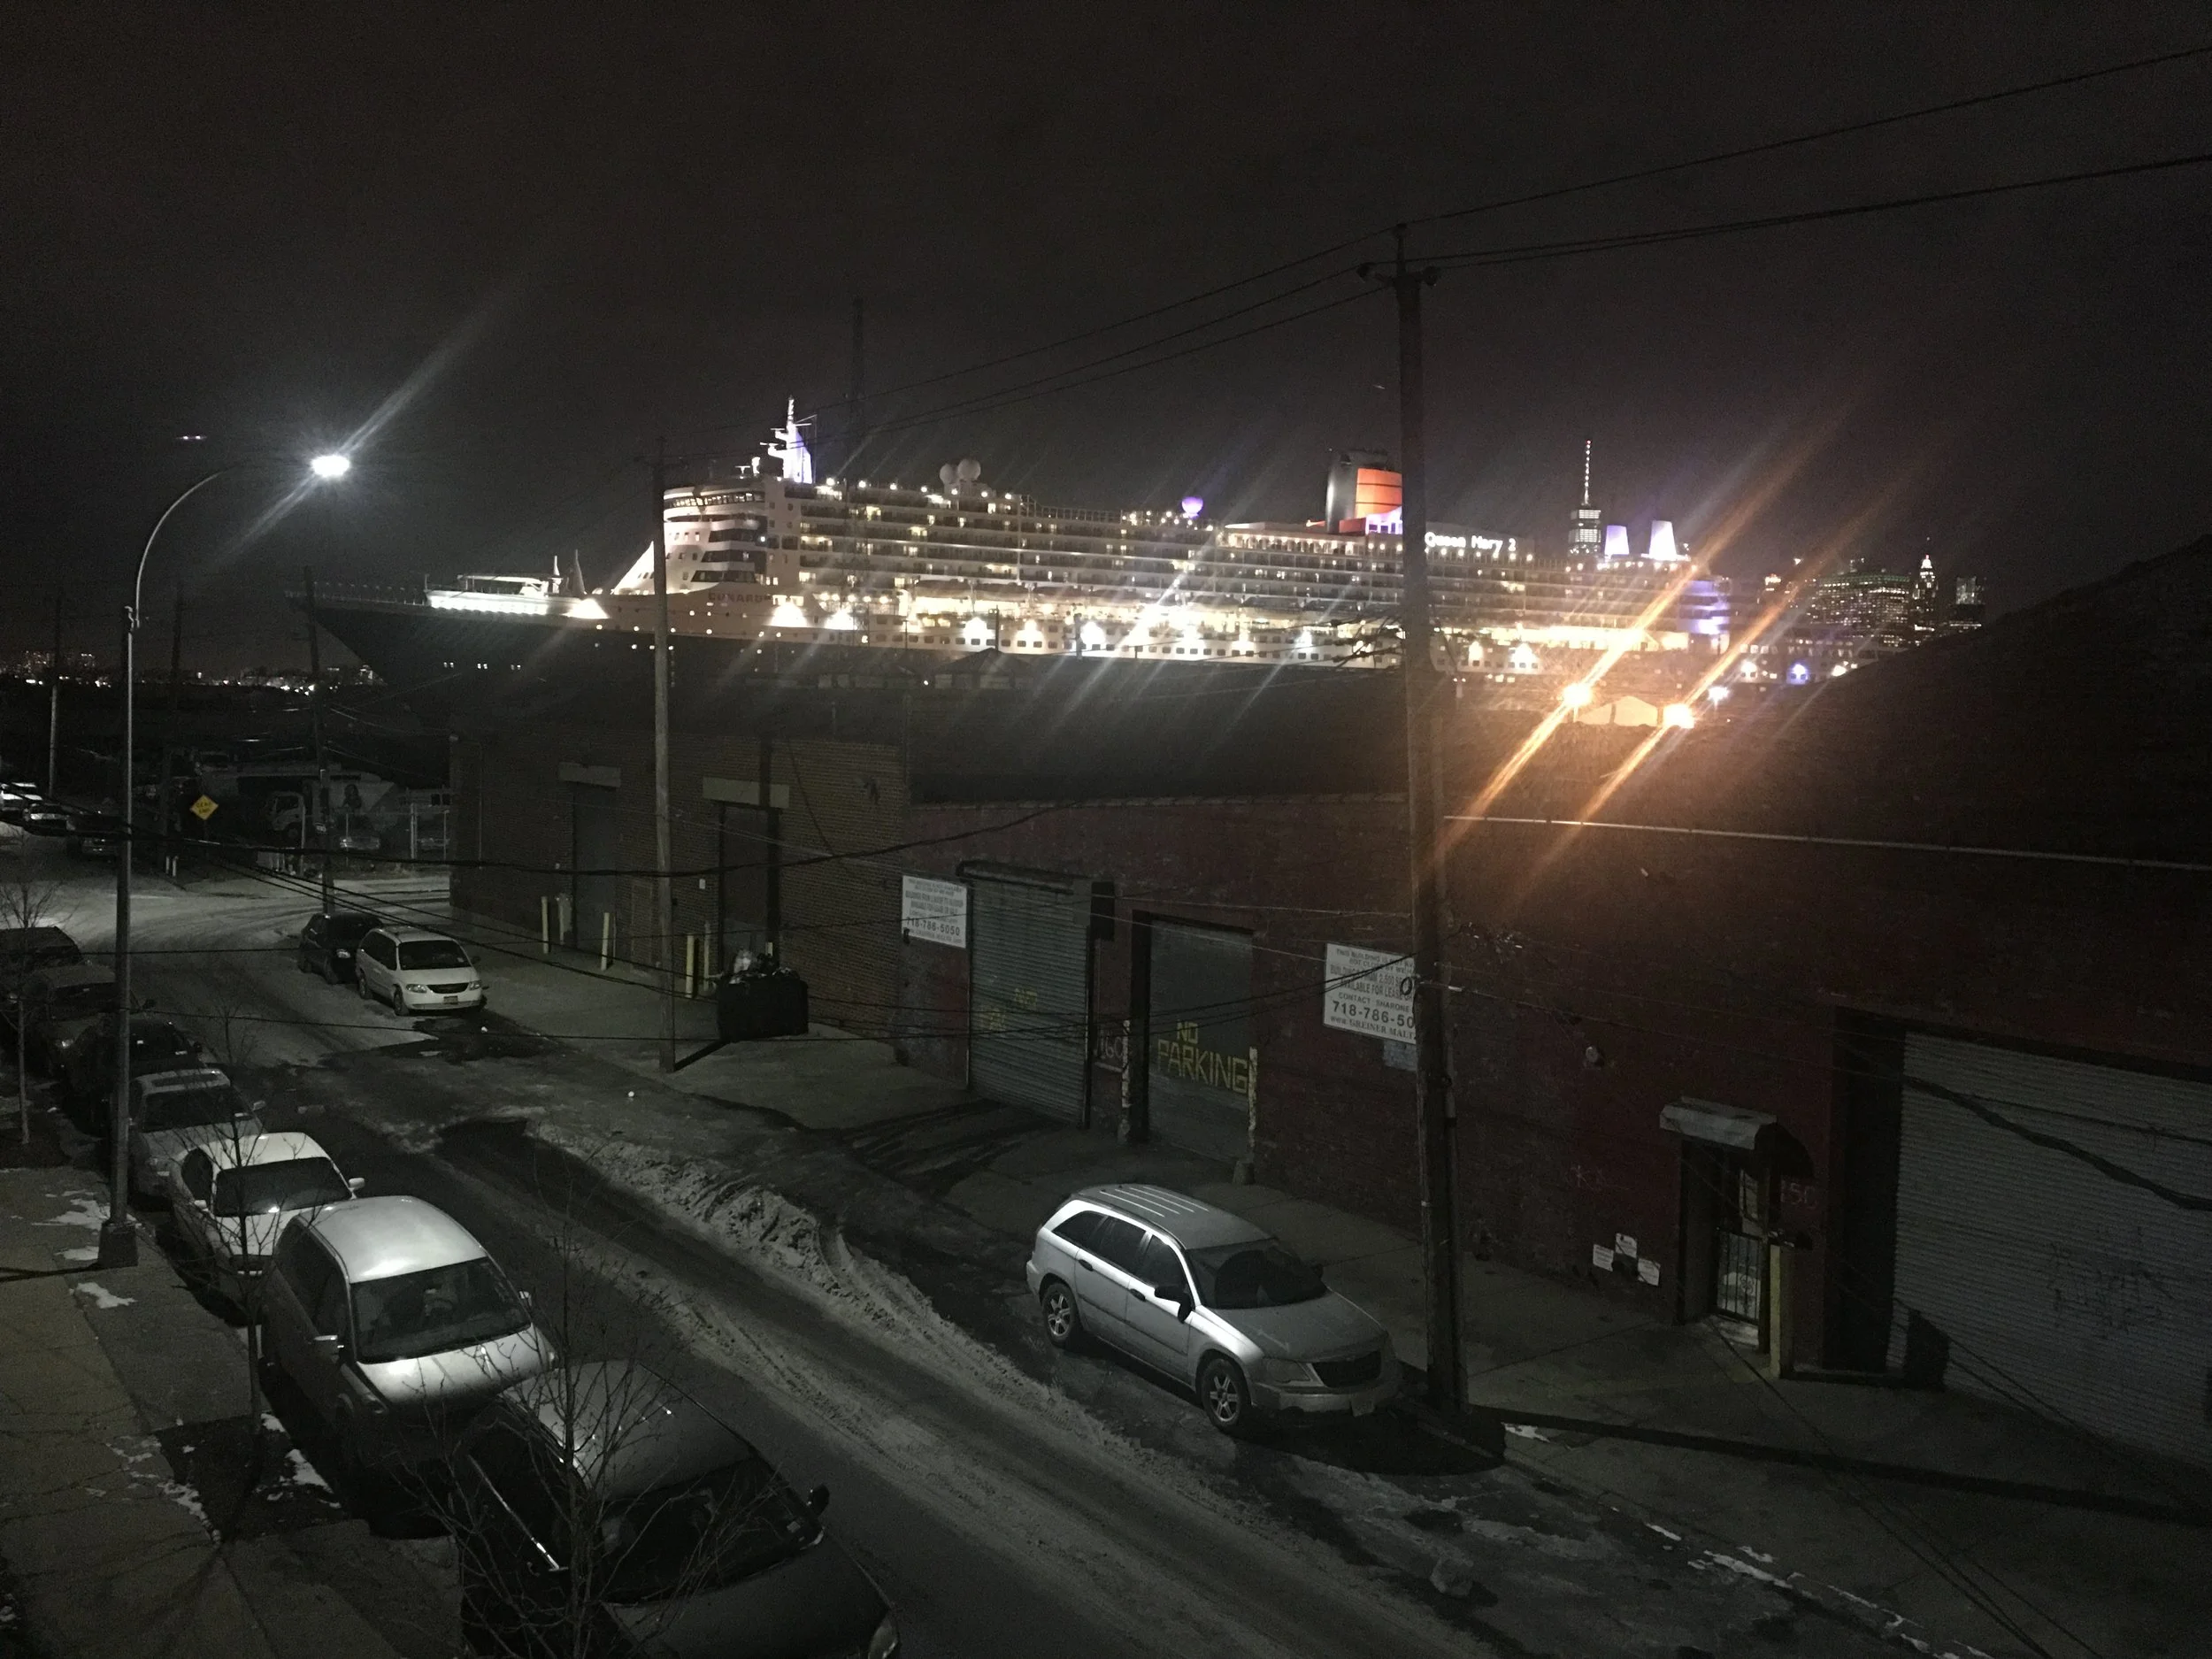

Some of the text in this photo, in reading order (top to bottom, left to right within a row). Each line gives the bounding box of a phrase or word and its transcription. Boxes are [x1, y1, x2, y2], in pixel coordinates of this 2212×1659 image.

[1471, 534, 1503, 553] Mary
[1508, 537, 1517, 551] 2
[1338, 992, 1371, 1005] CONTACT
[1177, 1019, 1198, 1044] NO
[1349, 1018, 1386, 1035] GREINER
[1157, 1039, 1248, 1094] PARKING
